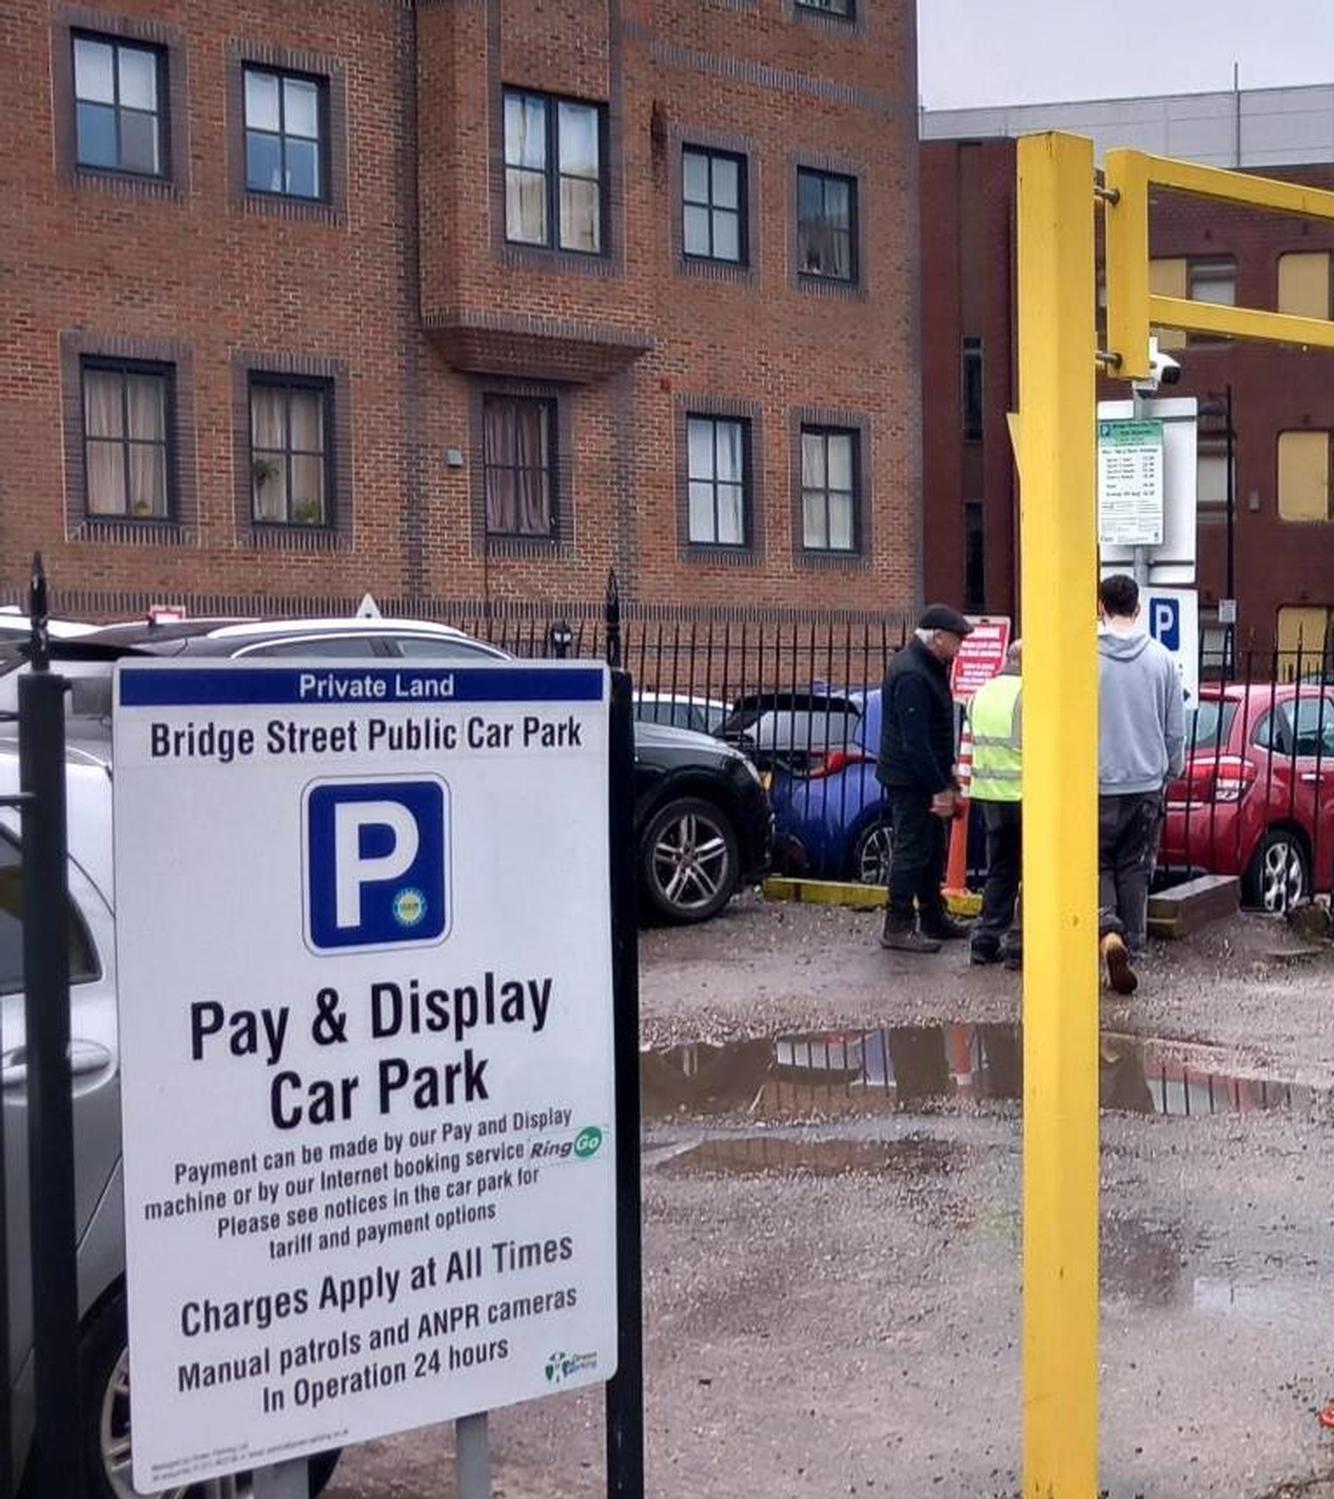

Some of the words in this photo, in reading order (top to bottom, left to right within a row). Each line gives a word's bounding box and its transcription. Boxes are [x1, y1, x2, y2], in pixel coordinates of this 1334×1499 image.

[1156, 604, 1174, 640] P
[300, 674, 386, 697] Private
[396, 674, 453, 697] Land
[152, 722, 254, 763] Bridge
[267, 720, 356, 754] Street
[369, 718, 456, 750] Public
[468, 717, 513, 748] Car
[524, 716, 581, 747] Park
[335, 800, 419, 928] P
[191, 1001, 289, 1066] Pay
[312, 988, 347, 1045] &
[371, 972, 552, 1042] Display
[271, 1071, 358, 1130] Car
[379, 1049, 488, 1114] Park
[145, 1191, 226, 1220] machine
[234, 1188, 252, 1205] or
[259, 1181, 279, 1204] by
[286, 1178, 314, 1197] our
[321, 1162, 388, 1191] Internet
[394, 1153, 460, 1178] booking
[466, 1142, 524, 1166] service
[175, 1153, 257, 1185] Payment
[264, 1151, 295, 1170] can
[302, 1145, 323, 1164] be
[330, 1135, 377, 1160] made
[384, 1132, 403, 1154] by
[409, 1129, 437, 1147] our
[442, 1123, 472, 1143] Pay
[478, 1114, 507, 1137] and
[513, 1107, 572, 1132] Display
[218, 1213, 280, 1238] Please
[287, 1207, 318, 1226] see
[325, 1194, 387, 1219] notices
[394, 1188, 408, 1207] in
[414, 1184, 440, 1204] the
[446, 1180, 472, 1199] car
[477, 1170, 512, 1197] park
[518, 1167, 539, 1186] for
[270, 1232, 312, 1259] tariff
[319, 1226, 350, 1250] and
[357, 1212, 429, 1248] payment
[436, 1204, 496, 1231] options
[182, 1289, 308, 1337] Charges
[319, 1266, 400, 1312] Apply
[411, 1257, 436, 1290] at
[446, 1247, 481, 1283] All
[492, 1237, 572, 1273] Times
[179, 1348, 269, 1392] Manual
[280, 1331, 361, 1376] patrols
[370, 1318, 409, 1350] and
[418, 1304, 479, 1339] ANPR
[488, 1288, 576, 1324] cameras
[264, 1387, 284, 1413] In
[294, 1363, 406, 1408] Operation
[415, 1349, 441, 1378] 24
[449, 1339, 508, 1370] hours
